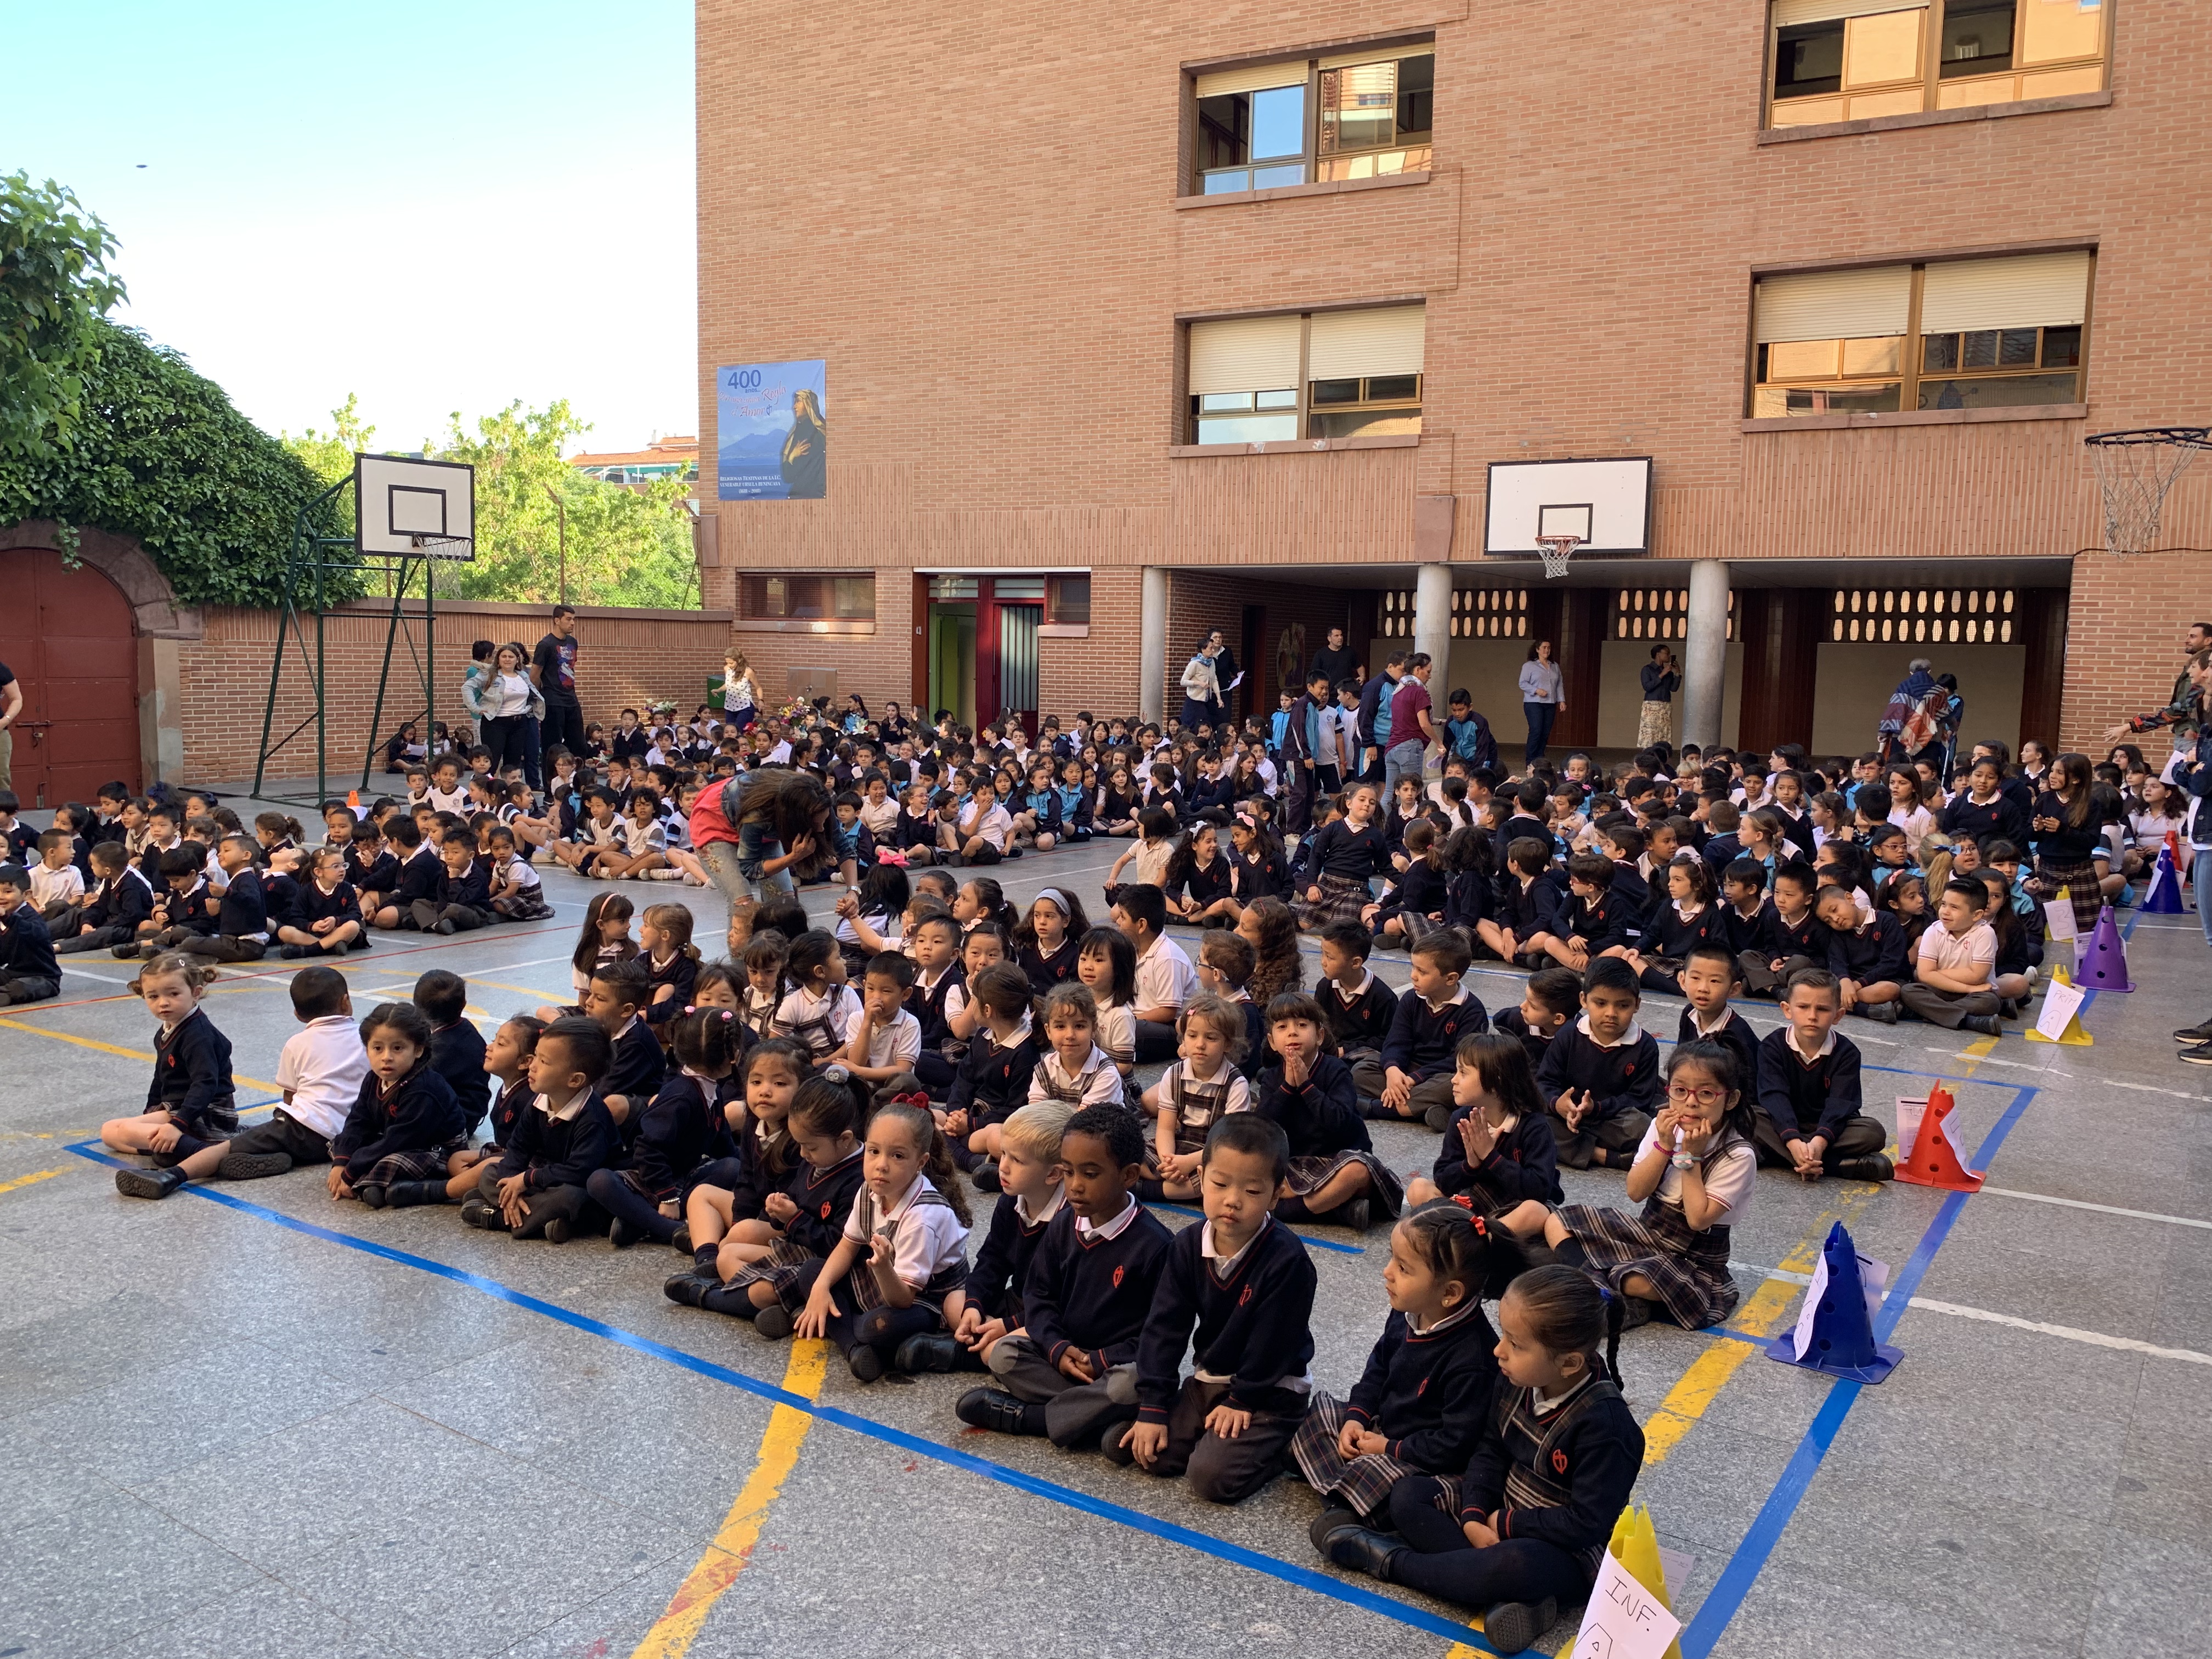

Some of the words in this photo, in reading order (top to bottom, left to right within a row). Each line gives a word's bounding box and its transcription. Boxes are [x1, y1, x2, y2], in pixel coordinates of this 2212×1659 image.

[727, 370, 761, 389] 400
[761, 380, 786, 405] Regla
[740, 405, 765, 417] Amor
[2053, 905, 2075, 936] 3
[2038, 1009, 2062, 1035] A
[1605, 1576, 1657, 1632] INF.
